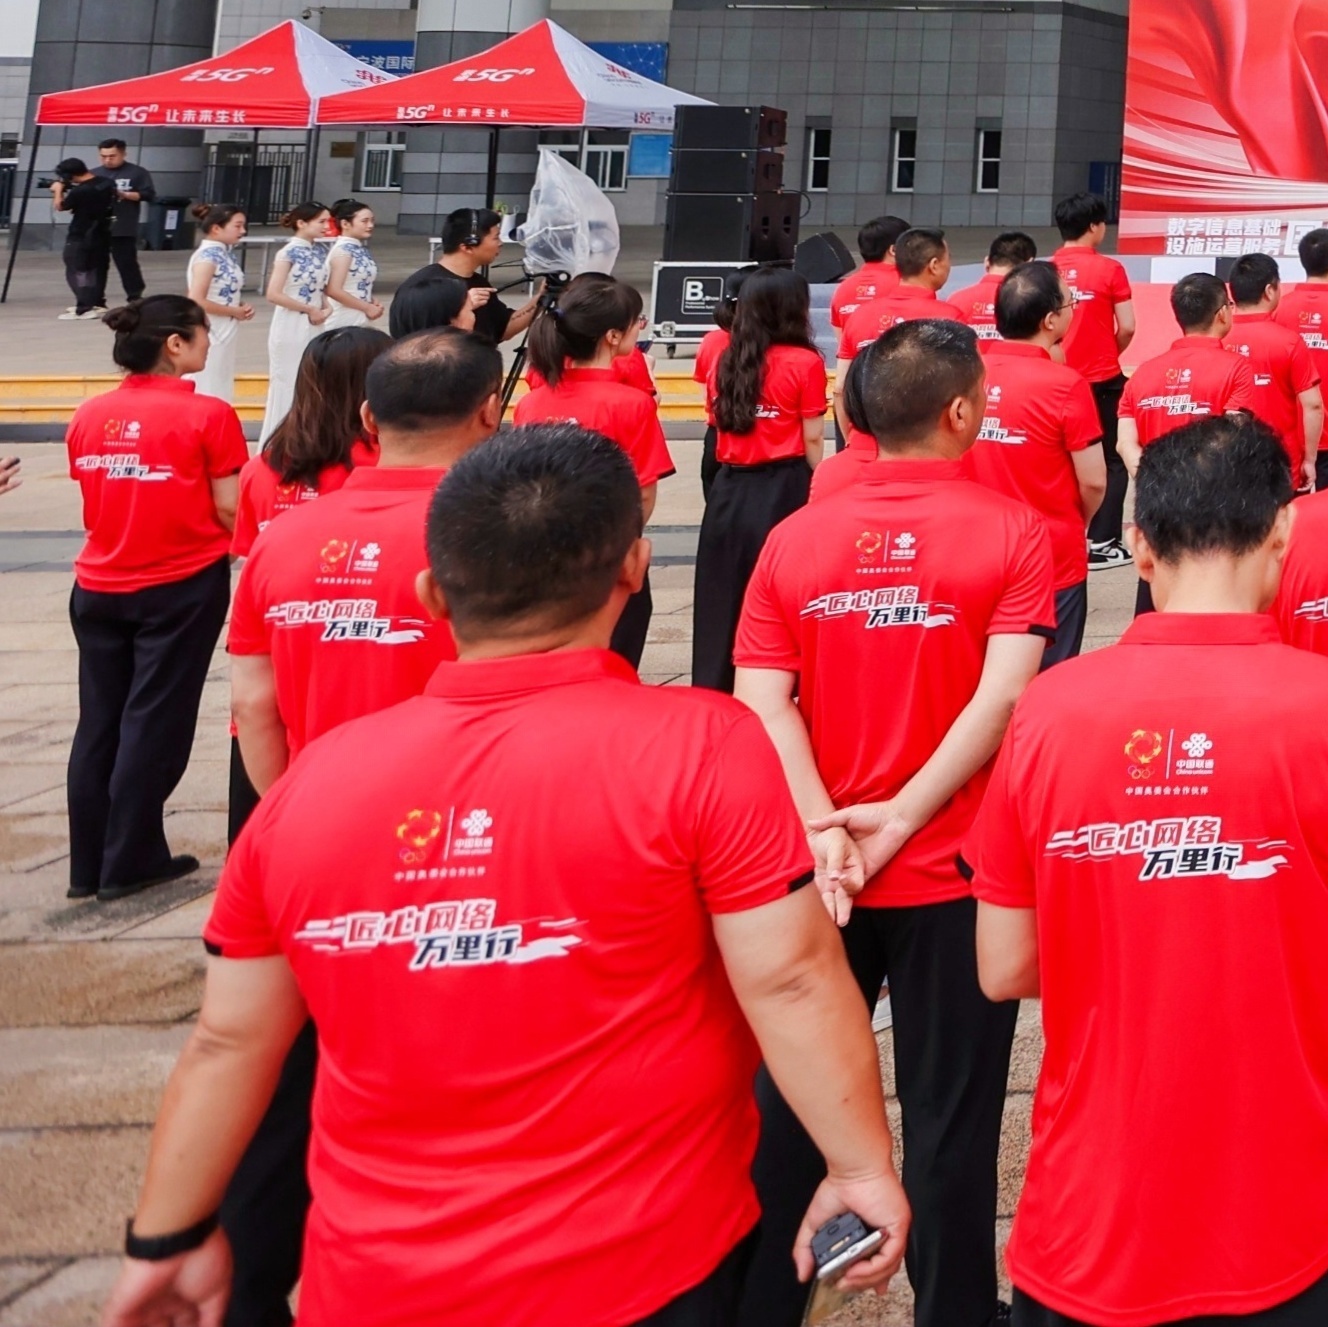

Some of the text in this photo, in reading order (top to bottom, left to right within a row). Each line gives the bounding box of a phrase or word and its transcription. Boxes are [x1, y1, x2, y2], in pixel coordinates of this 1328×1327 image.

[1167, 218, 1281, 236] 数字信息基础
[1166, 237, 1281, 256] 设施运营服务
[286, 599, 377, 625] 匠心网络
[825, 586, 919, 615] 匠心网络
[865, 603, 928, 629] 万里行
[321, 619, 391, 642] 万里行
[1088, 817, 1222, 856] 匠心网络
[1138, 843, 1243, 881] 万里行
[344, 900, 496, 949] 匠心网络
[409, 925, 523, 972] 万里行
